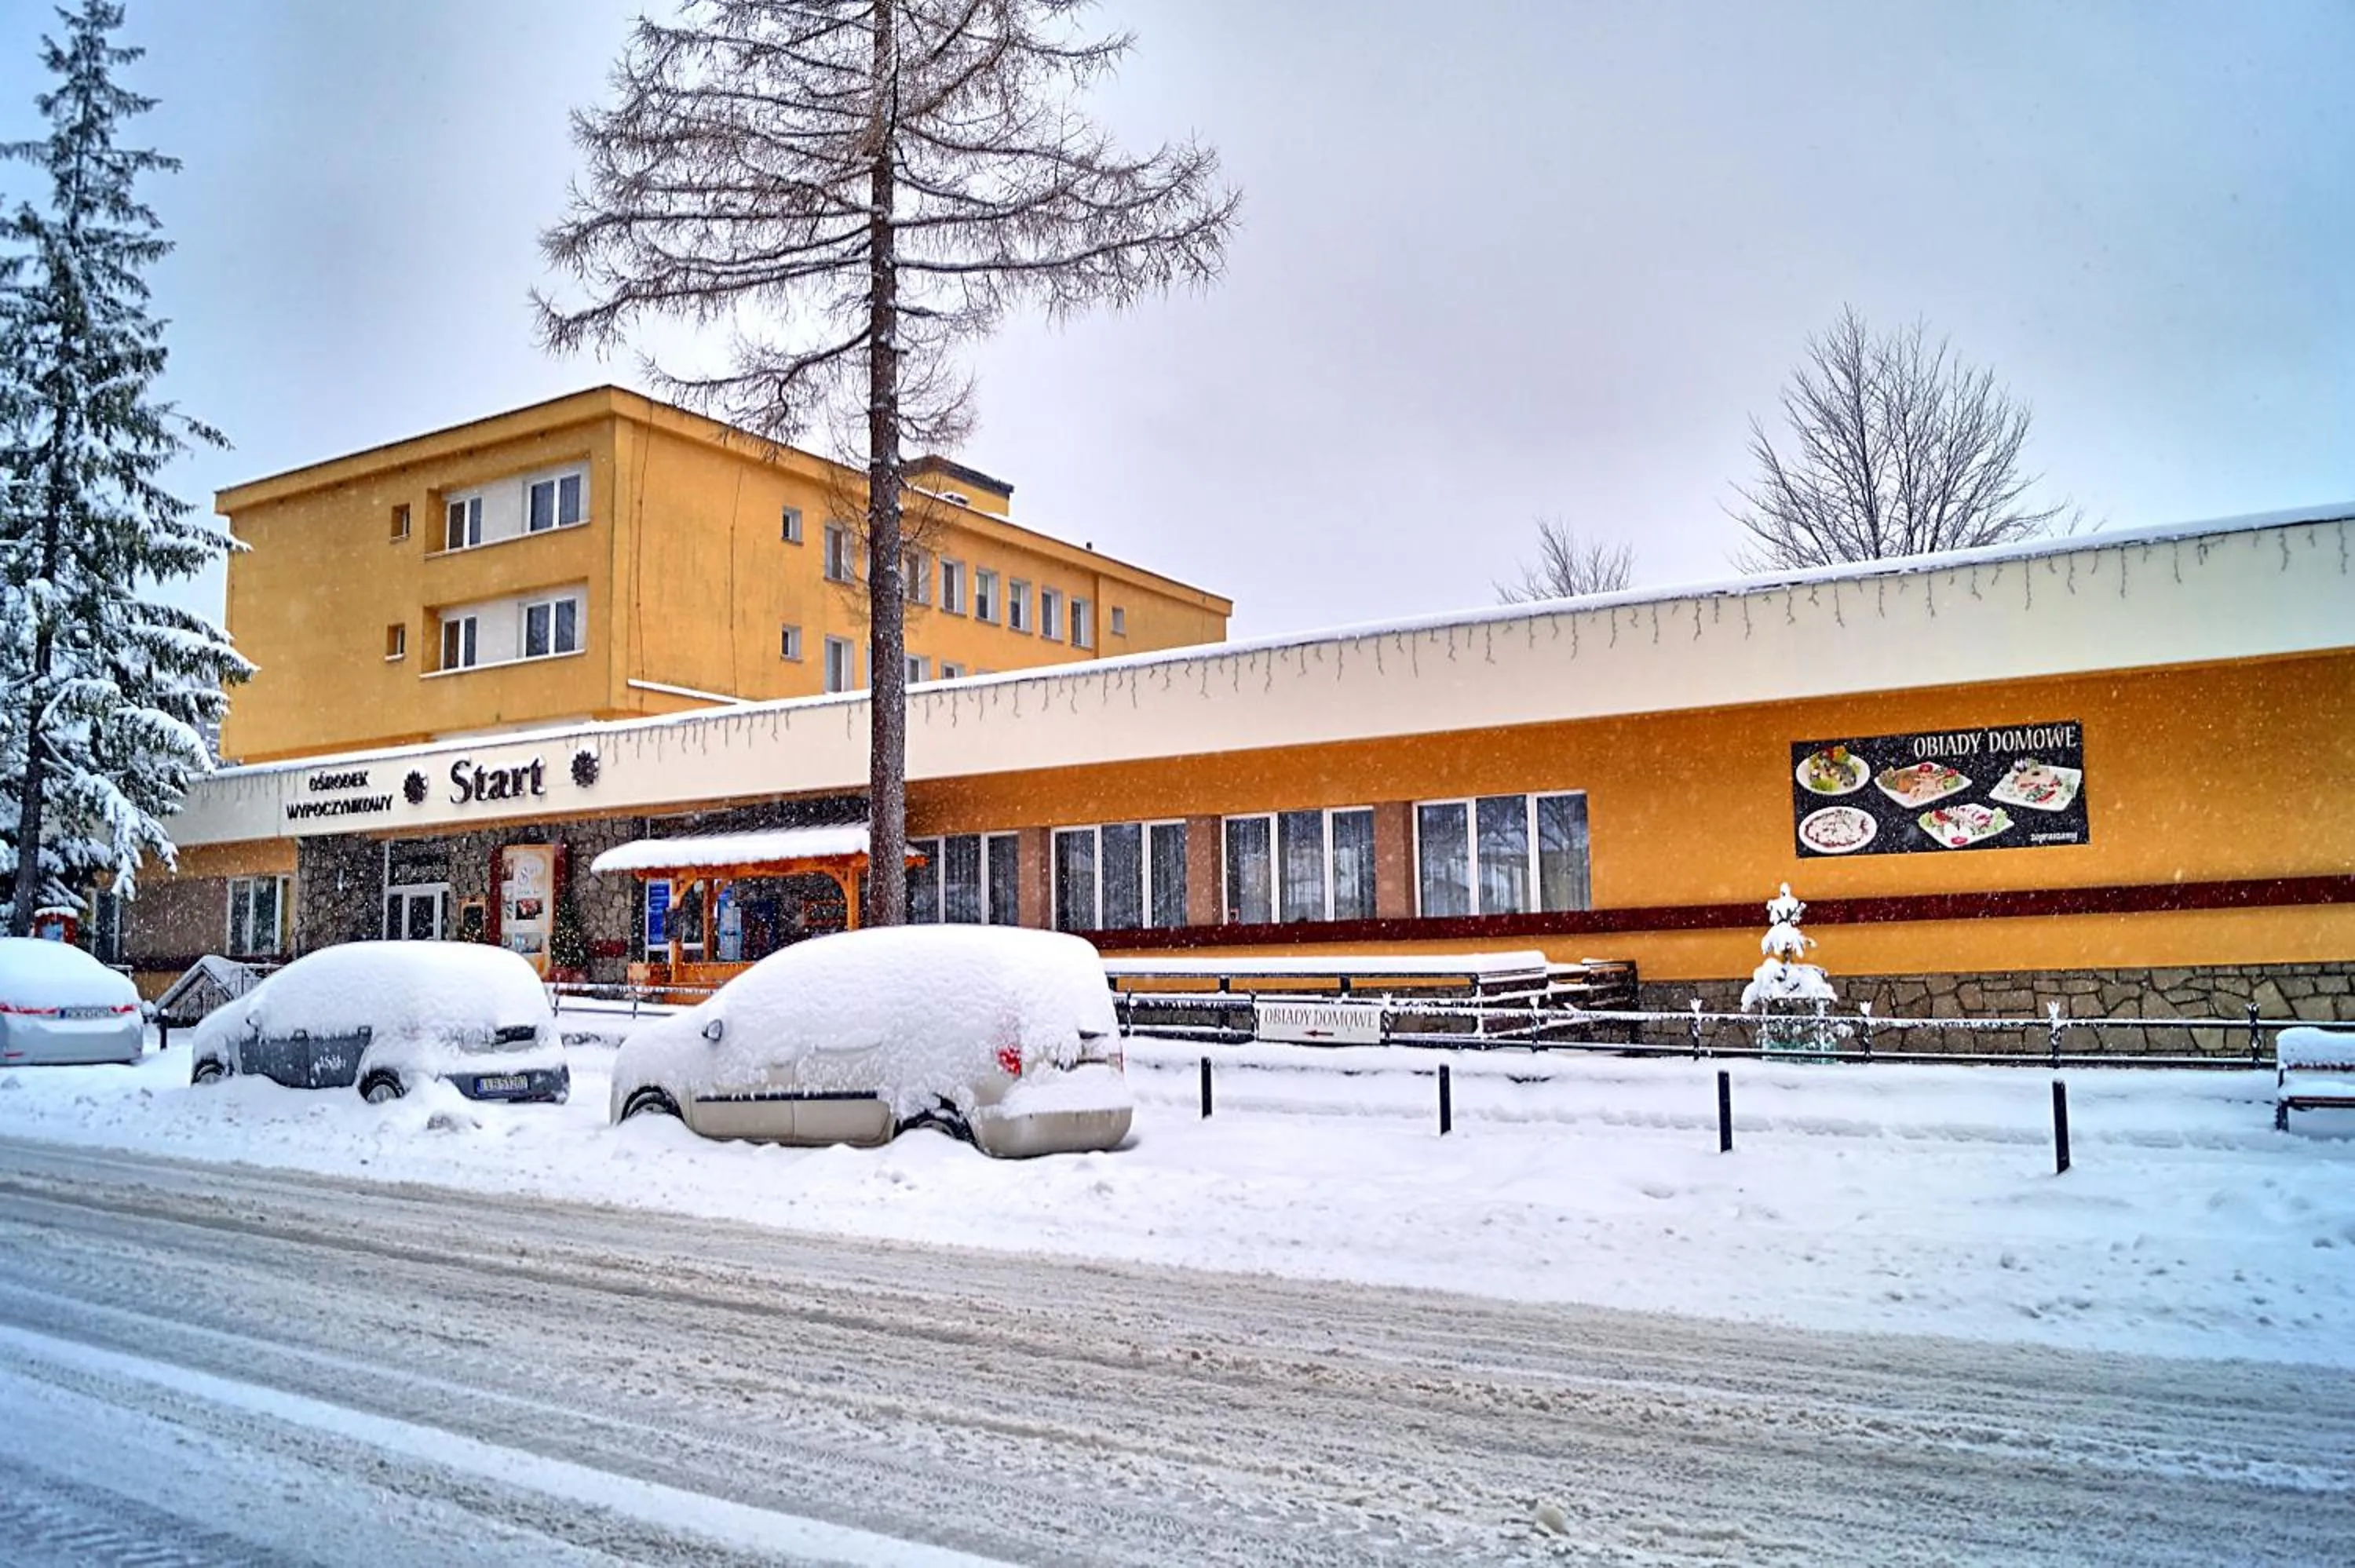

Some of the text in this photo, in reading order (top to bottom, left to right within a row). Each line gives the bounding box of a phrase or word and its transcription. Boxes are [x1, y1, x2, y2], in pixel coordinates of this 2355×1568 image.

[1914, 726, 2077, 758] OBIADY DOMOWE
[309, 770, 369, 792] OŚRODEK
[450, 756, 547, 804] Start
[287, 794, 393, 820] WYPOCZYNKOWY
[1264, 1008, 1375, 1028] OBIADY DOMOWE
